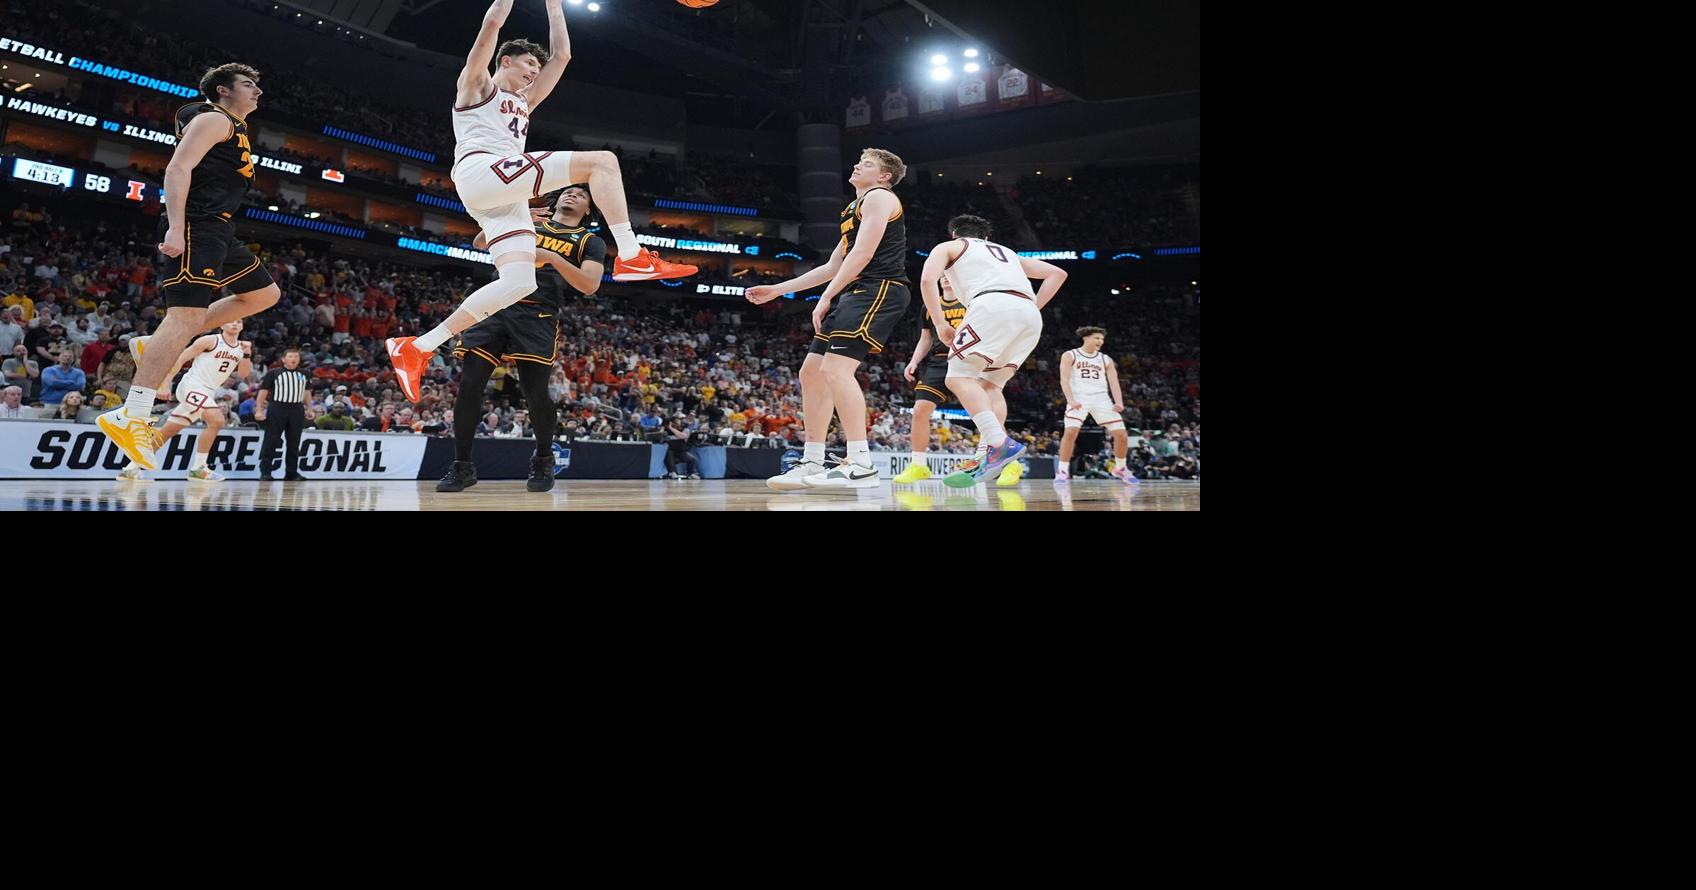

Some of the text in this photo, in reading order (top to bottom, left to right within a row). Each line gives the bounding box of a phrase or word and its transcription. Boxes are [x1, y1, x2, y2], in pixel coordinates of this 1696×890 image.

[68, 57, 199, 98] CHAMPIONSHIP
[7, 97, 98, 127] HAWKEYES
[103, 120, 120, 132] VS
[260, 157, 303, 174] ILLINI
[27, 168, 60, 183] 4:13
[85, 173, 111, 193] 58
[398, 237, 495, 265] #MARCHMADNE
[536, 233, 574, 257] OWA
[636, 234, 676, 249] SOUTH
[676, 238, 741, 254] REGIONAL
[985, 244, 1008, 263] 0
[711, 285, 745, 296] ELITE
[218, 361, 230, 373] 2
[1080, 369, 1100, 380] 23
[30, 430, 197, 470] SOUH
[890, 456, 913, 475] RIC
